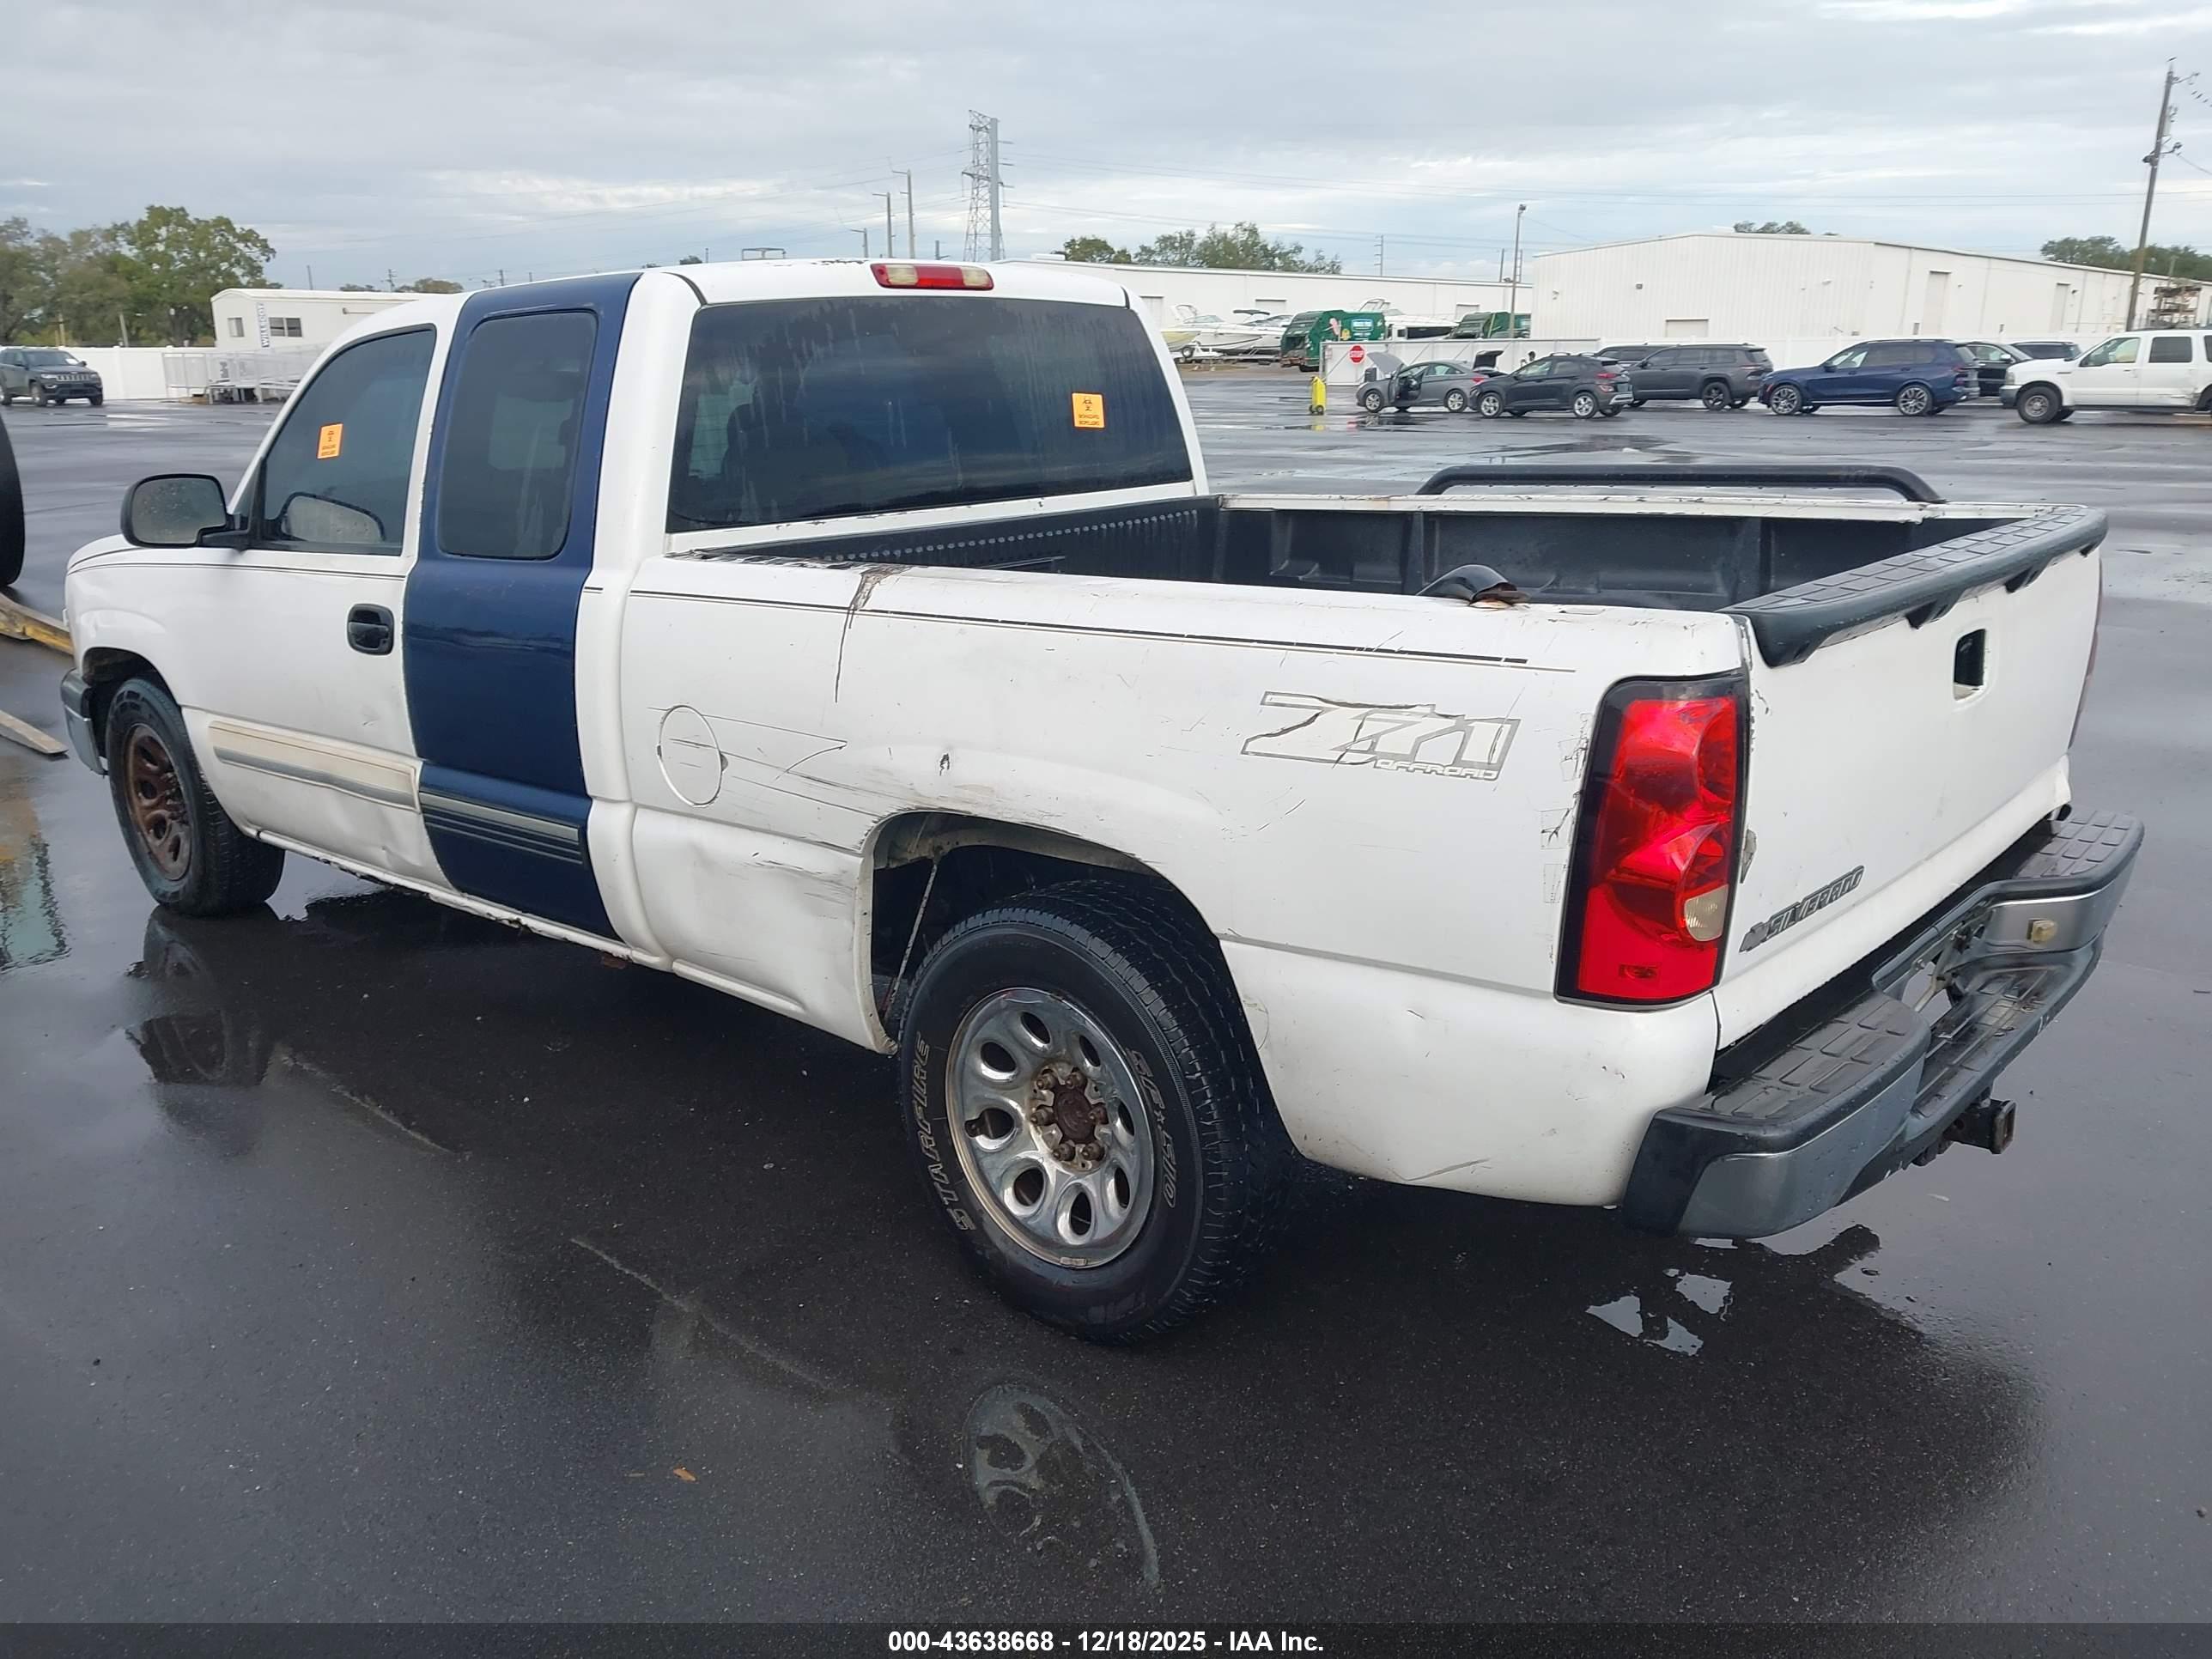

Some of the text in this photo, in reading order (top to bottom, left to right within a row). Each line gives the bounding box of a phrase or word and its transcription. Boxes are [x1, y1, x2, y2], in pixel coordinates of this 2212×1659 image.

[1241, 690, 1521, 765] Z71
[1765, 866, 1864, 944] SILVERADO
[911, 1030, 976, 1231] STARFIRE
